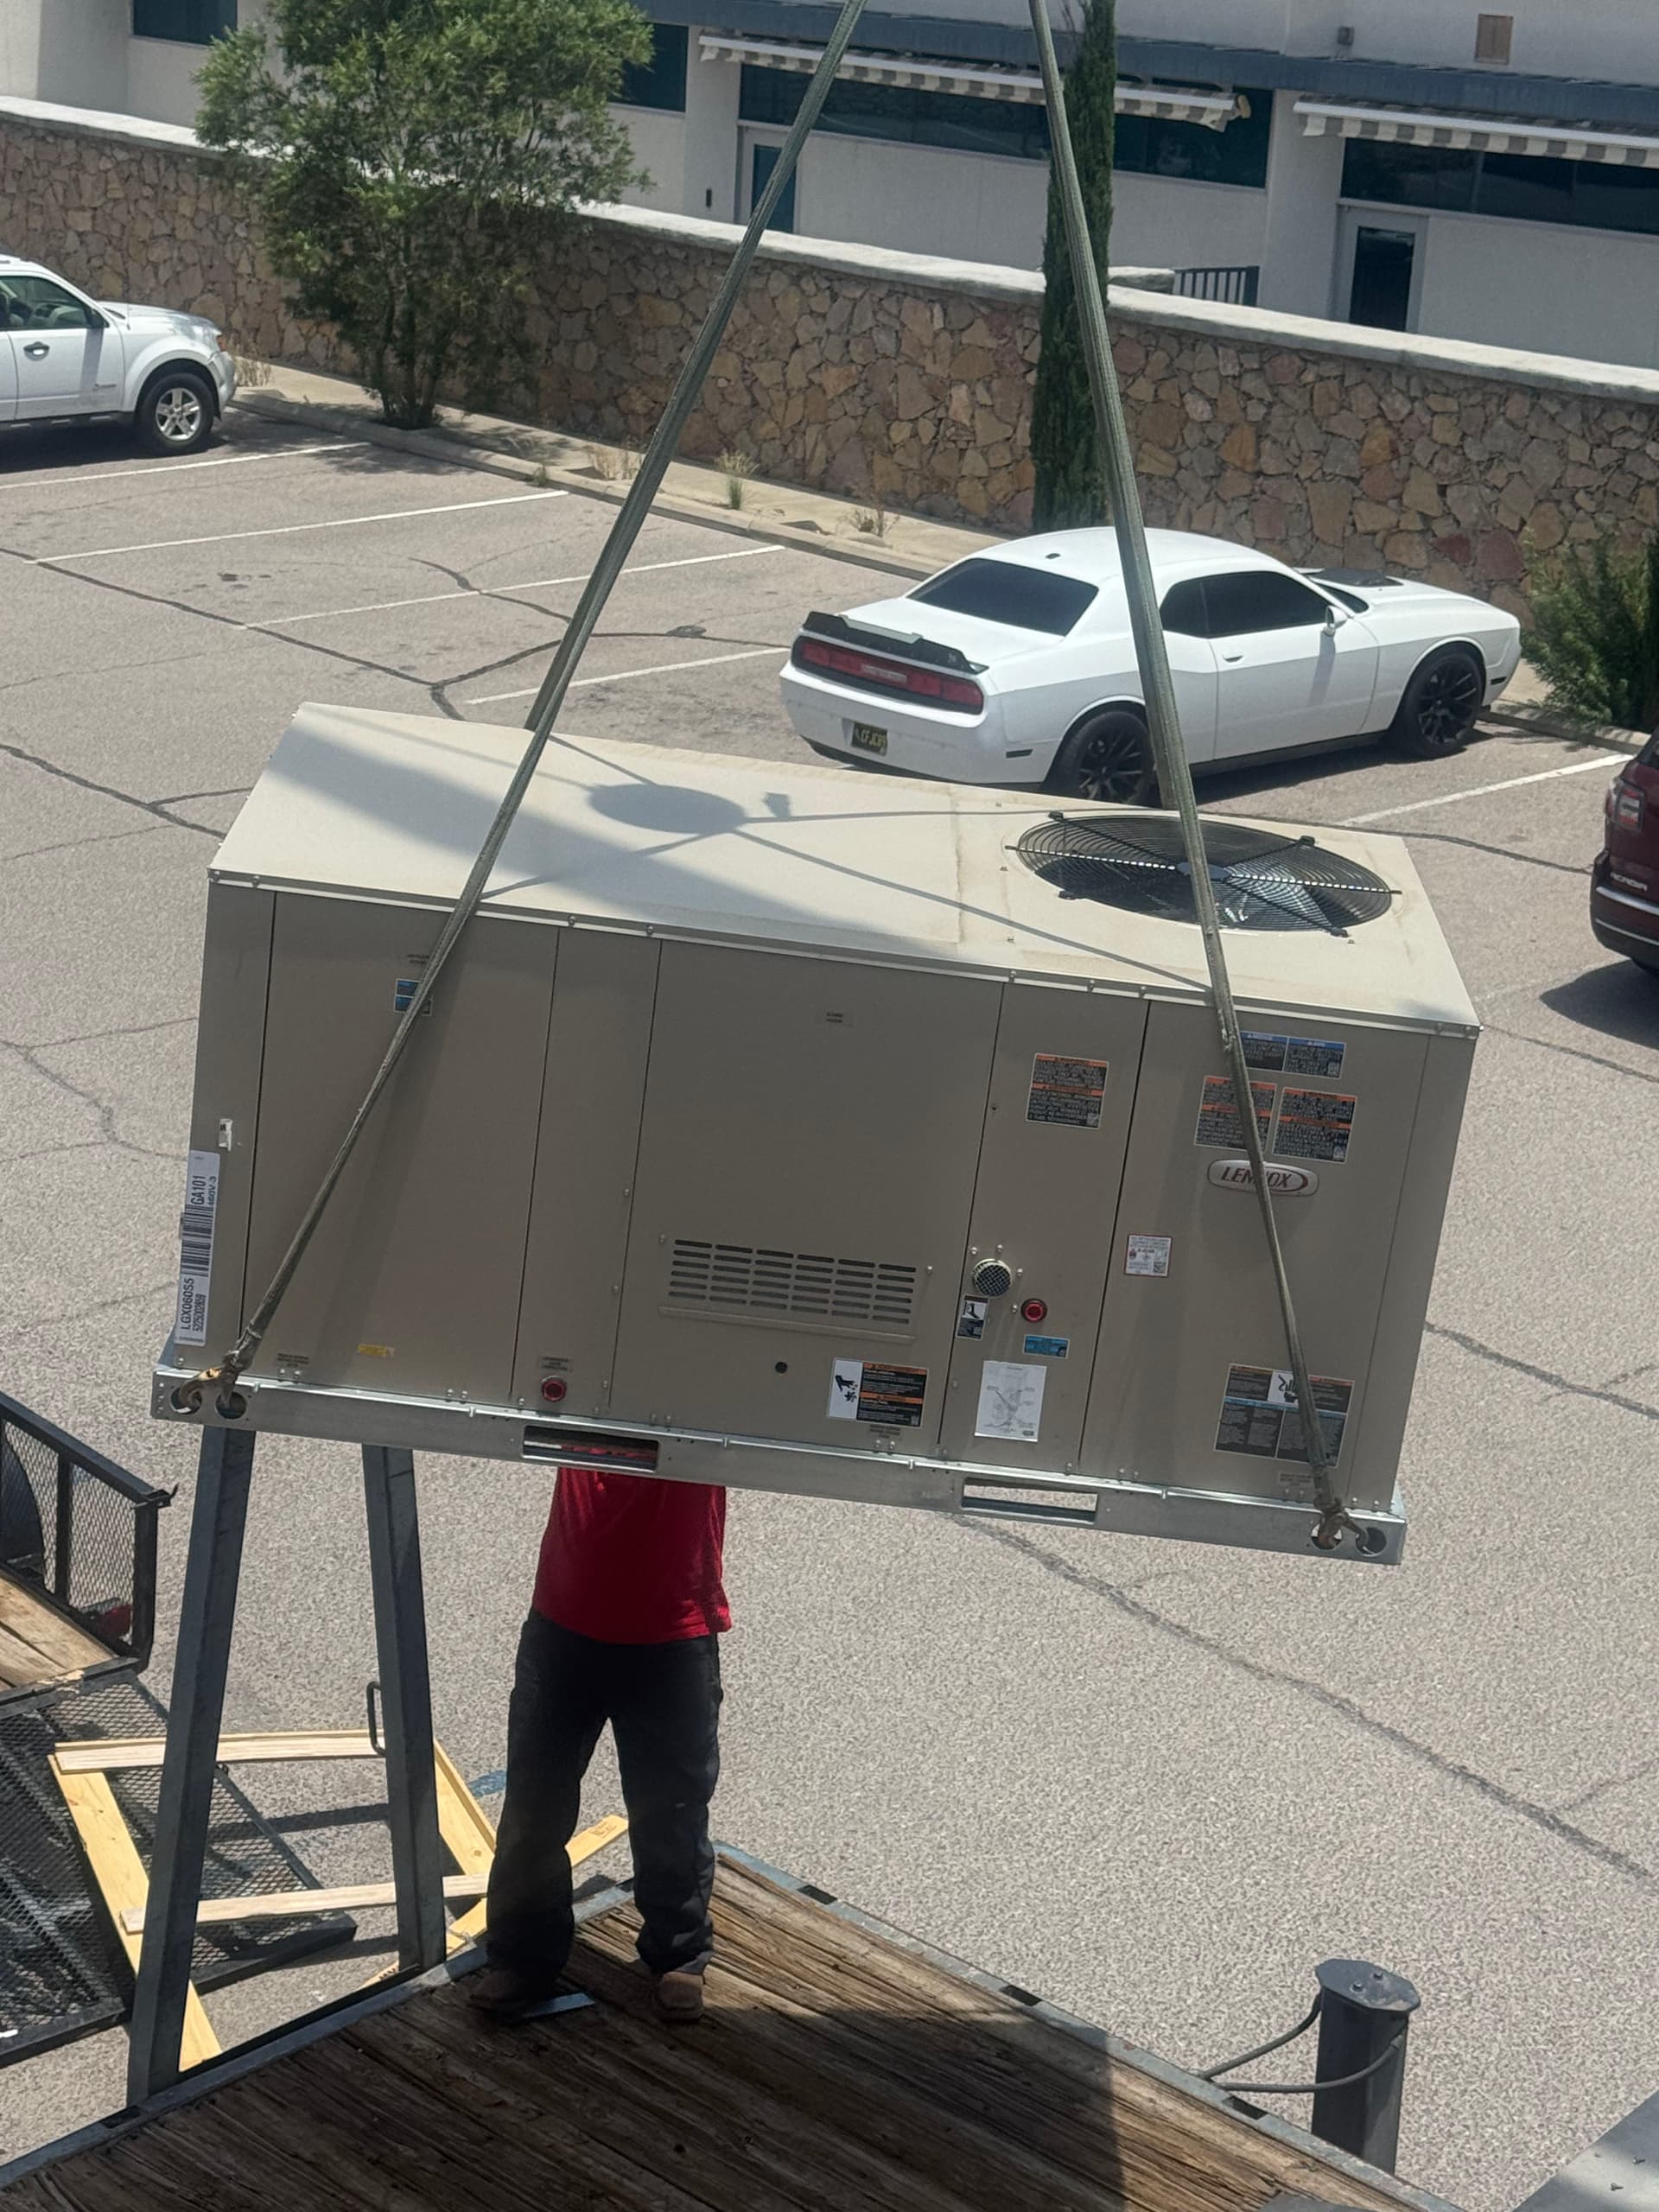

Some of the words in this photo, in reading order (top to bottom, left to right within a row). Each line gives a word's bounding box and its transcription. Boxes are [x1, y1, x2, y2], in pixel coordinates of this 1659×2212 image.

[190, 1175, 207, 1205] GA101
[1220, 1166, 1293, 1189] LENOX
[180, 1277, 194, 1331] LGX060S5
